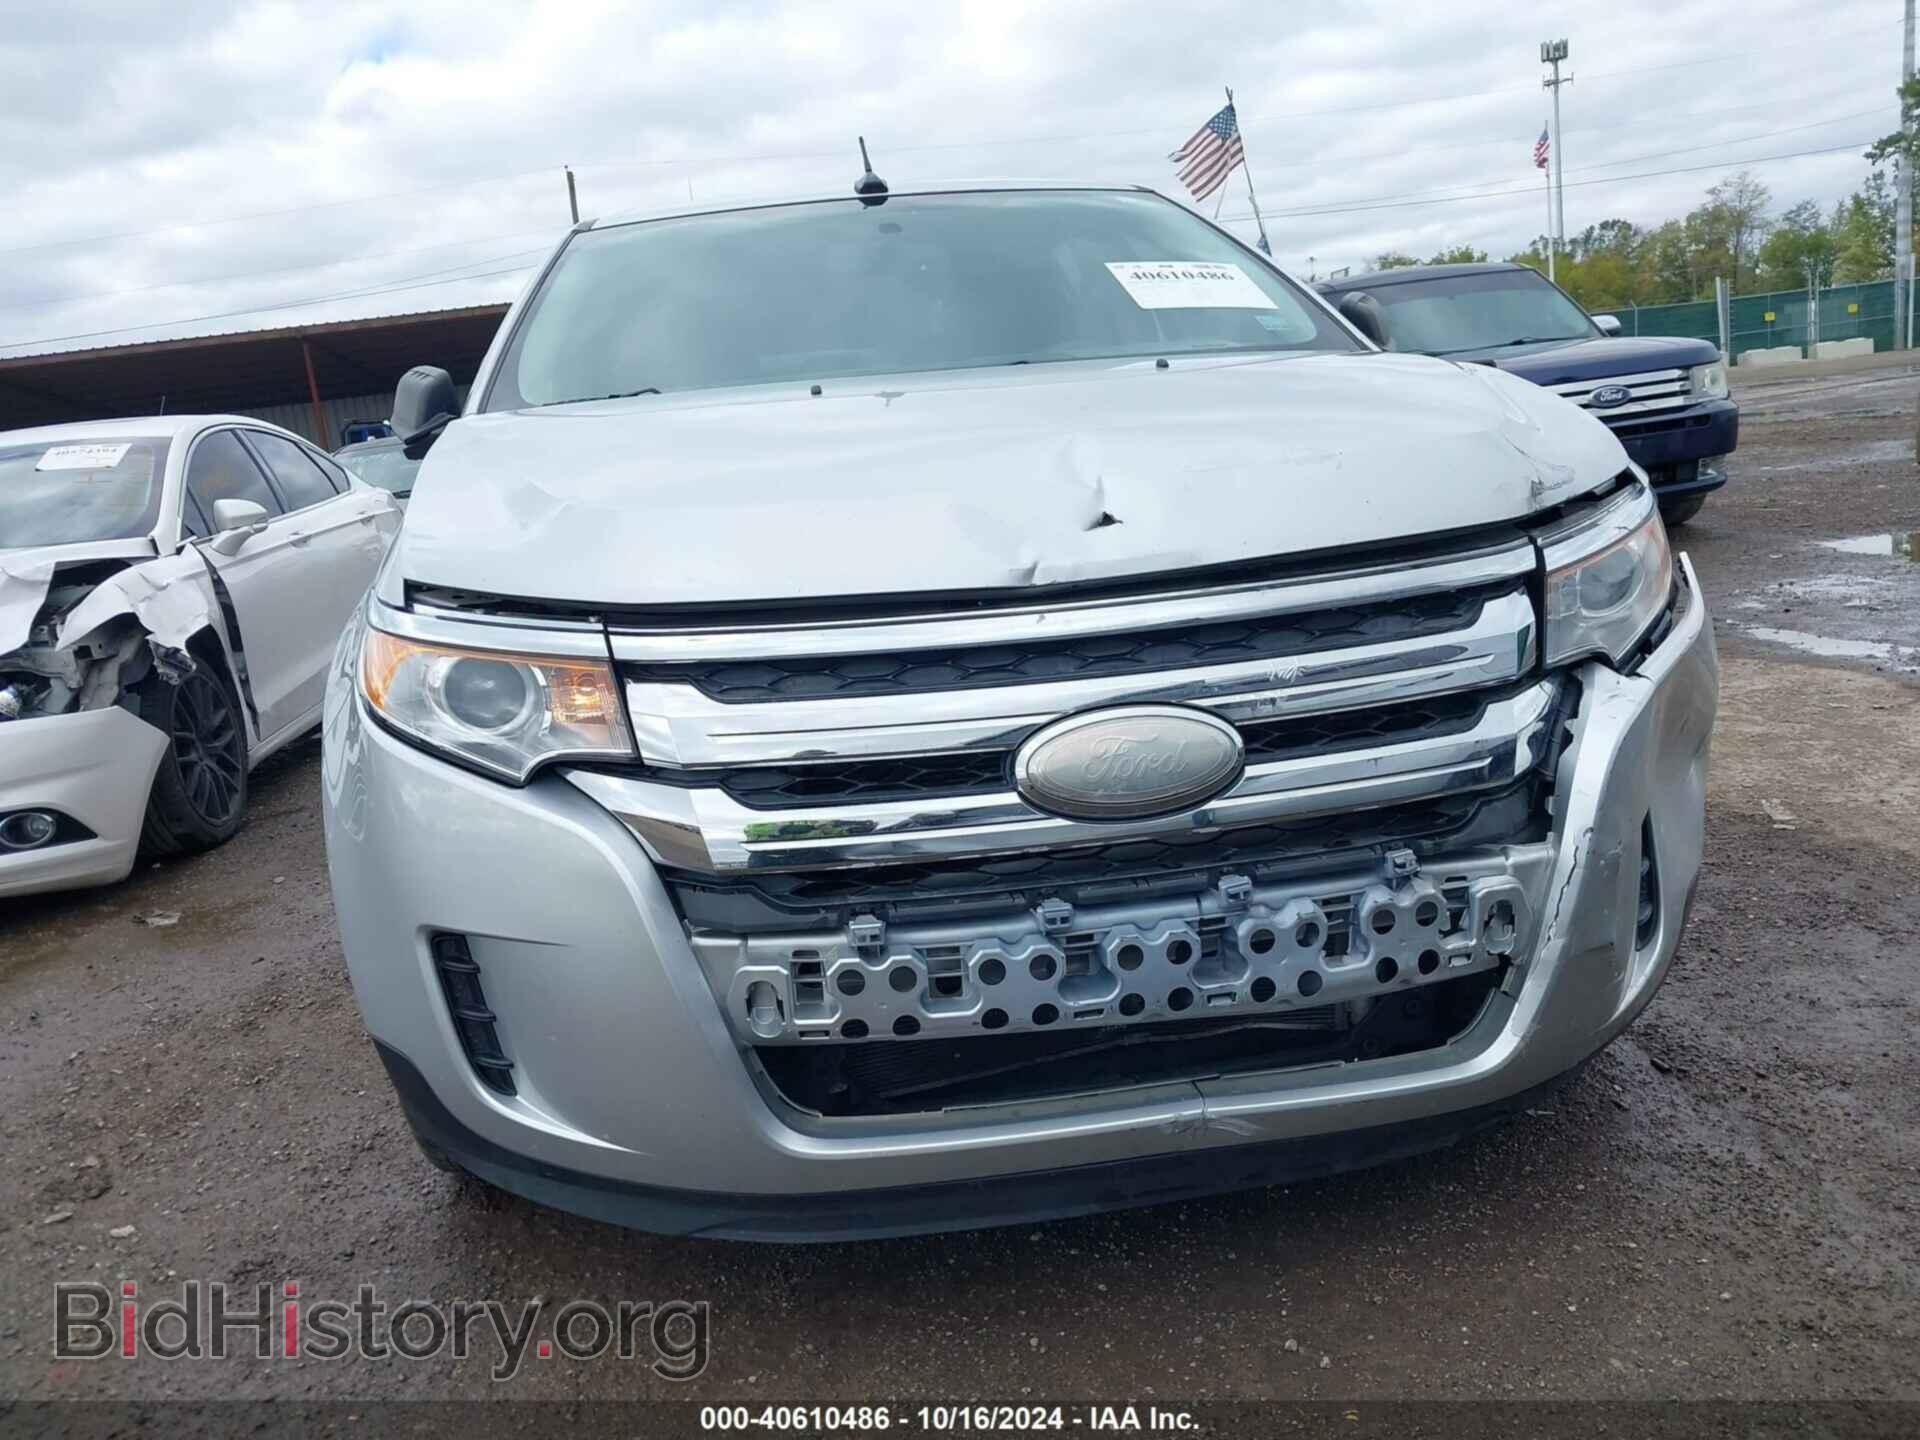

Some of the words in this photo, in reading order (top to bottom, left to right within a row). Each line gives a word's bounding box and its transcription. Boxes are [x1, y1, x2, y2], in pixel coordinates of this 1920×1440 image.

[1130, 271, 1235, 281] 40610486
[1600, 389, 1623, 402] Ford
[1082, 733, 1190, 779] Ford
